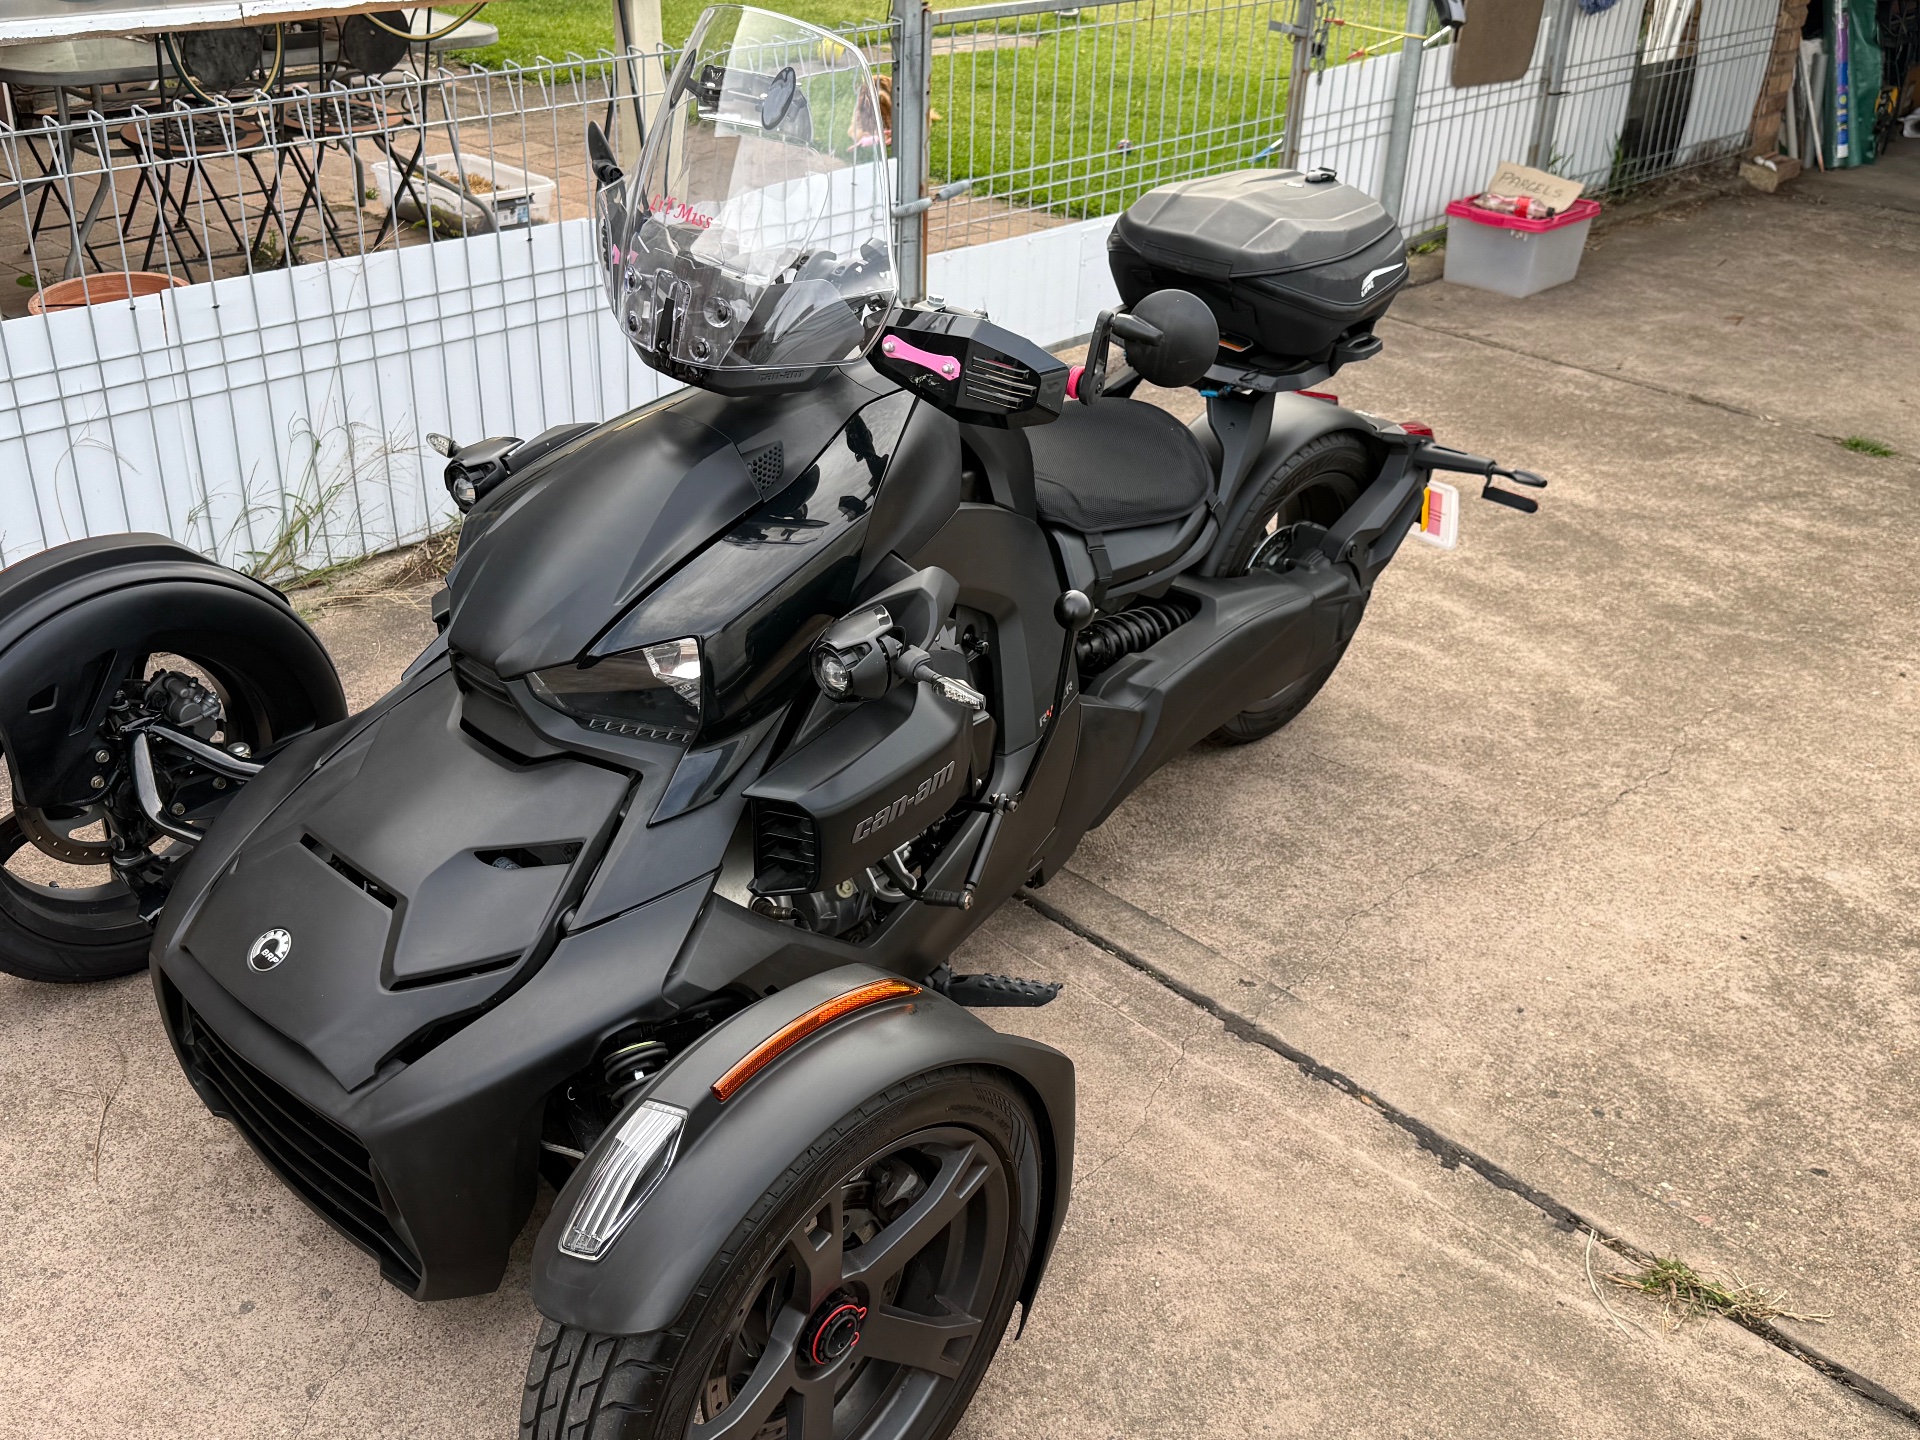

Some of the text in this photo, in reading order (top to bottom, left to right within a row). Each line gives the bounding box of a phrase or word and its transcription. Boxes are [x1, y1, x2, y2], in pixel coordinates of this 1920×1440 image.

[1497, 171, 1565, 199] PARCELS
[674, 203, 713, 229] Miss
[757, 369, 804, 384] can-am
[851, 760, 956, 844] can-am
[261, 948, 280, 964] BRP
[710, 1231, 776, 1328] KENDA
